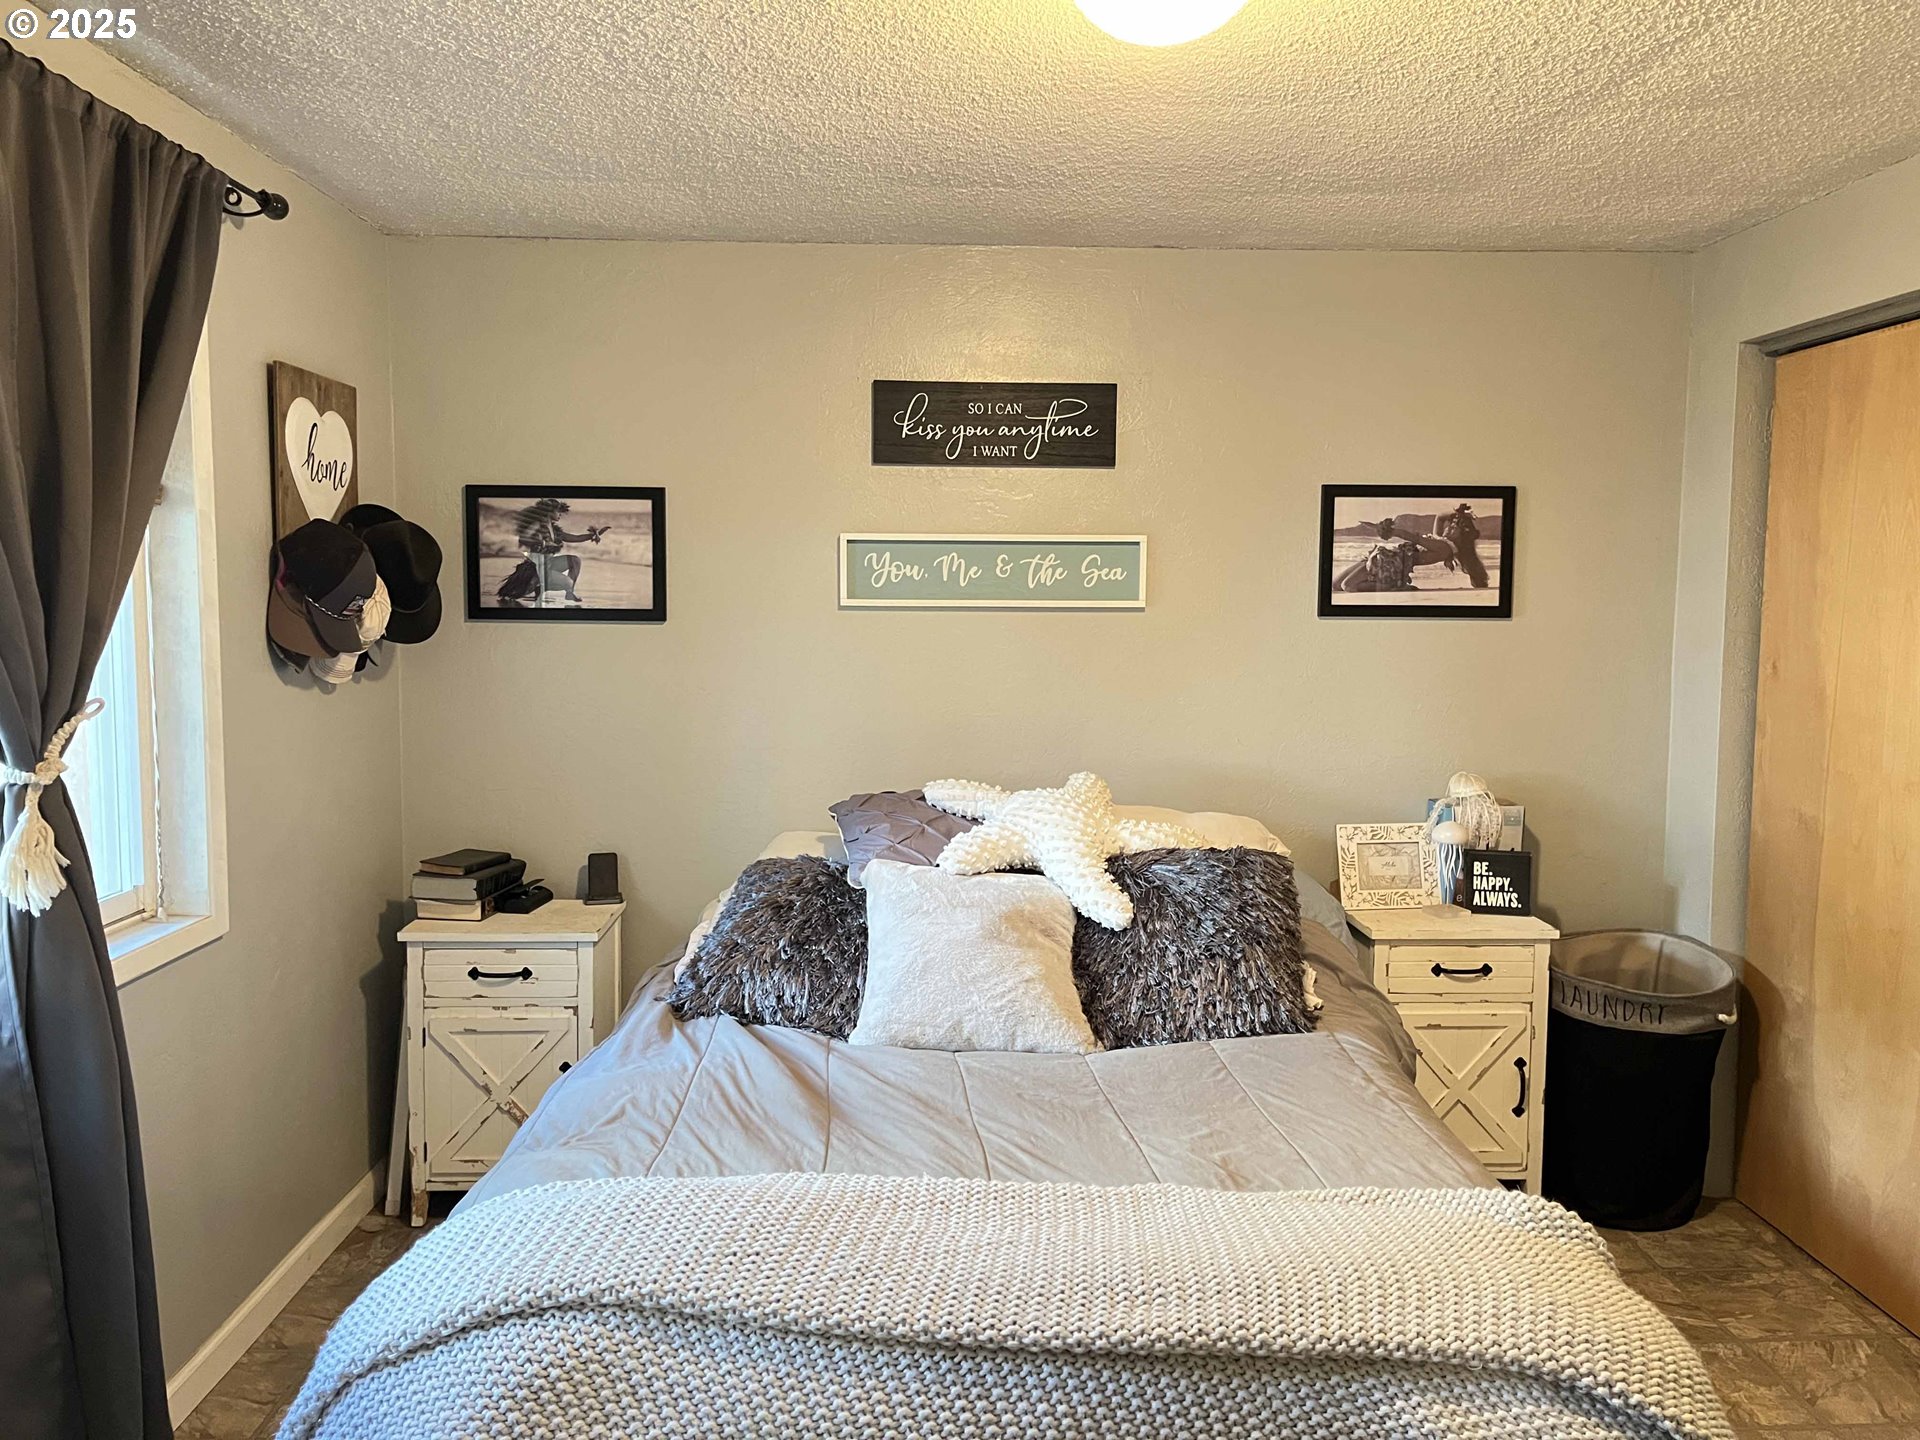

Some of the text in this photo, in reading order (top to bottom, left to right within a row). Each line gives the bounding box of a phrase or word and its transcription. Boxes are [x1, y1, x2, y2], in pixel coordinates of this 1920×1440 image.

[967, 402, 1023, 415] SO I CAN
[893, 392, 1100, 460] kiss you anytime
[301, 422, 348, 492] home
[973, 446, 1018, 457] I WANT
[933, 551, 983, 588] Me
[995, 554, 1014, 578] &
[1080, 554, 1127, 588] Sea
[1473, 861, 1494, 876] BE.
[1472, 875, 1514, 892] HAPPY.
[1472, 890, 1522, 908] ALWAYS.
[1560, 980, 1668, 1025] LAUNDRY
